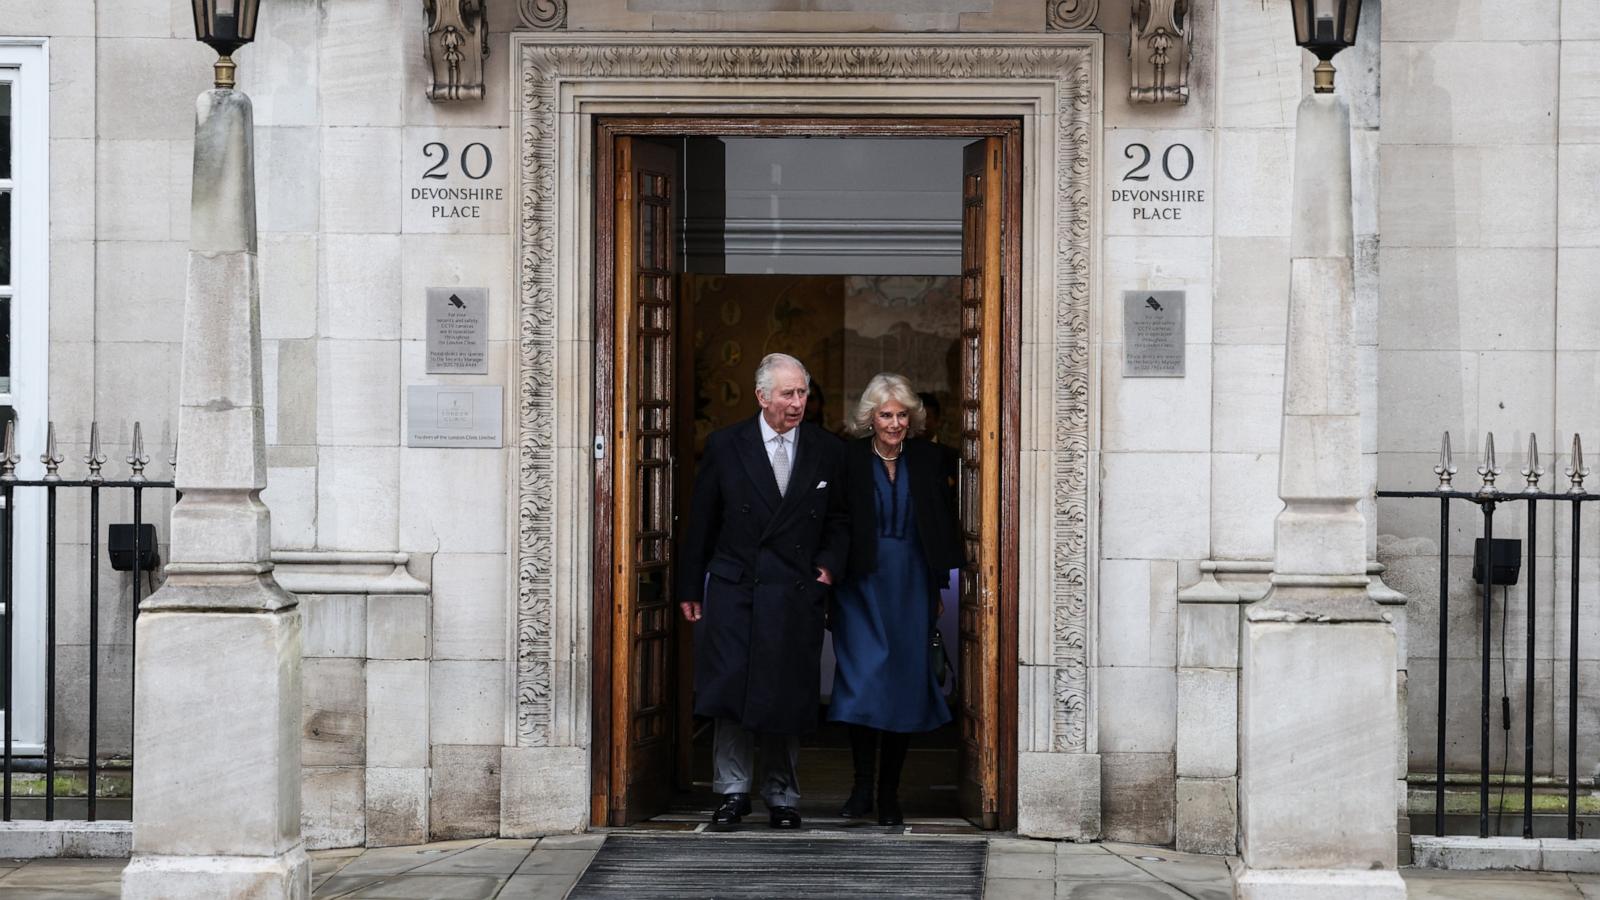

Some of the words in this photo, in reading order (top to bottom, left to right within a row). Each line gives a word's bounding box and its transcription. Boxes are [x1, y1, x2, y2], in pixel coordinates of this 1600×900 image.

[422, 142, 492, 180] 20
[1122, 143, 1194, 182] 20
[411, 188, 503, 201] DEVONSHIRE
[1112, 190, 1205, 202] DEVONSHIRE
[432, 206, 480, 218] PLACE
[1133, 208, 1181, 220] PLACE
